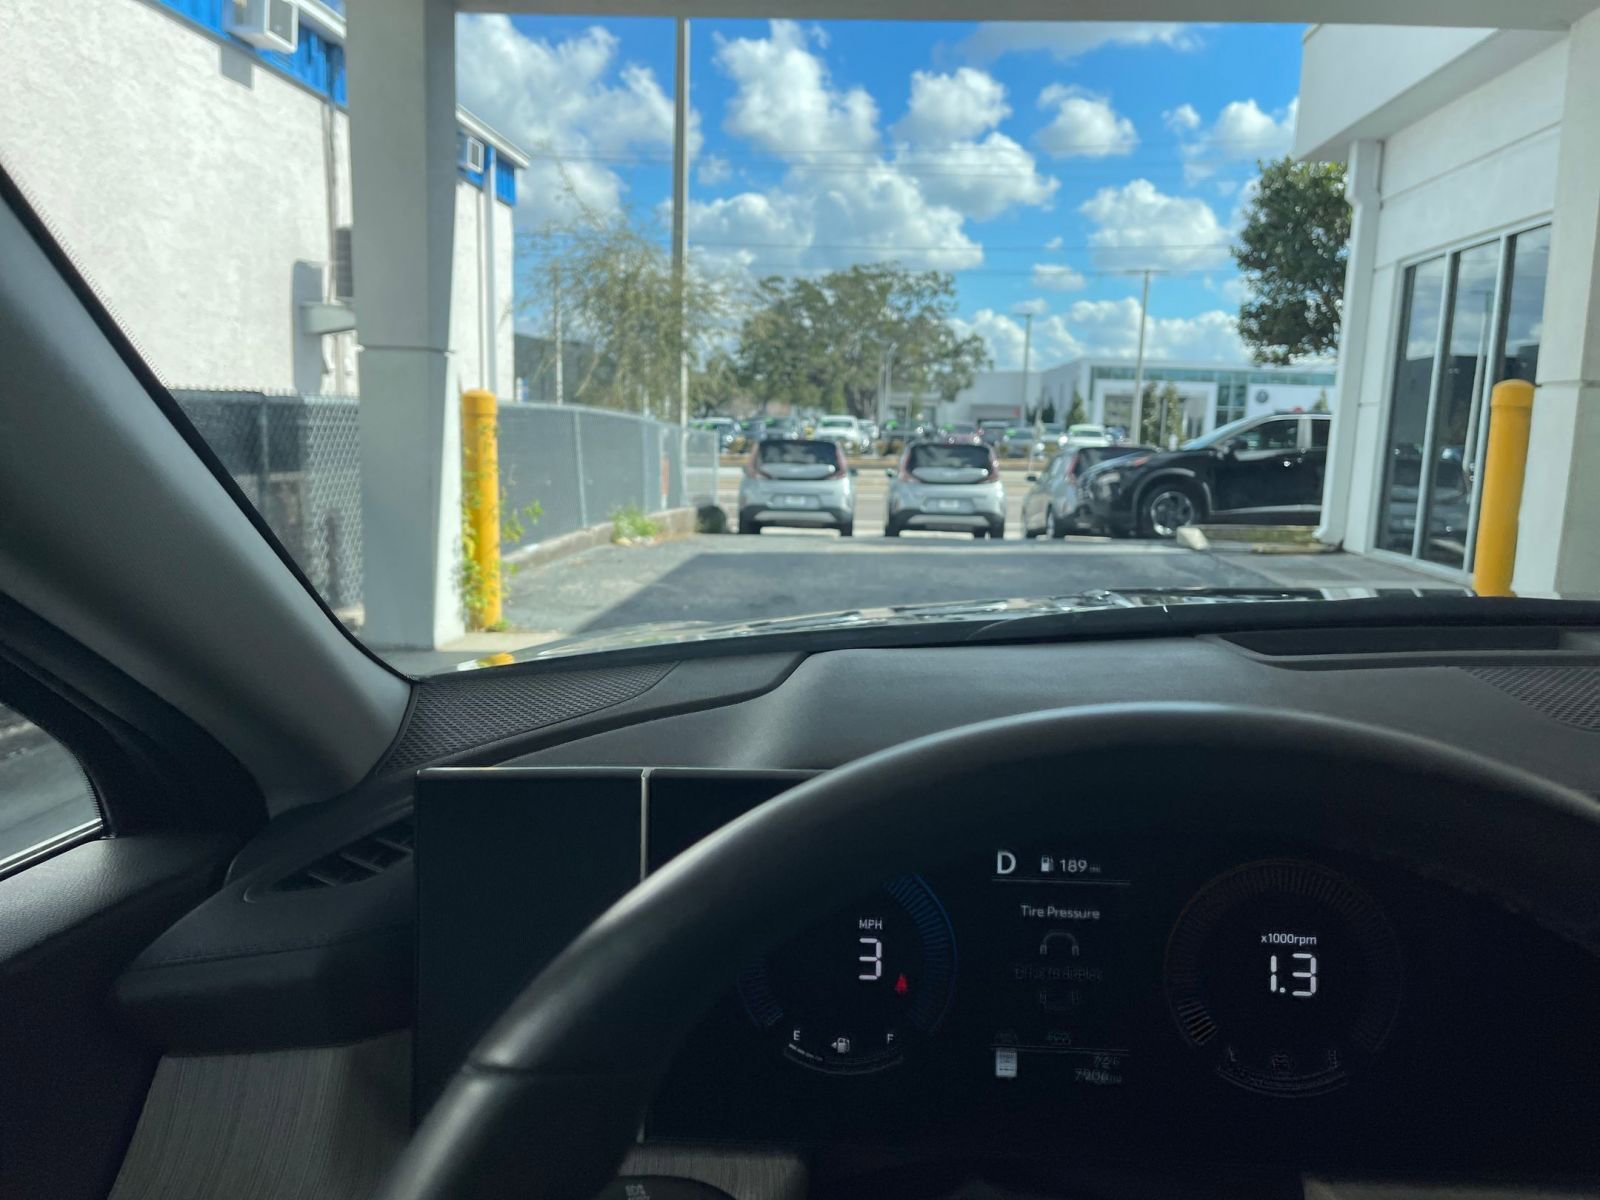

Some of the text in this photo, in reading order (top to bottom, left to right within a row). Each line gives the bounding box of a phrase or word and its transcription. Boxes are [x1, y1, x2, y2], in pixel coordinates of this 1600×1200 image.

[997, 850, 1016, 874] D
[1059, 859, 1088, 873] 189
[1020, 905, 1100, 920] Tire Pressure
[858, 918, 883, 930] MPH
[1261, 932, 1317, 946] x1000rpm
[858, 938, 882, 981] 3
[1270, 953, 1318, 997] 1.3
[793, 1029, 801, 1041] E
[886, 1033, 895, 1043] F
